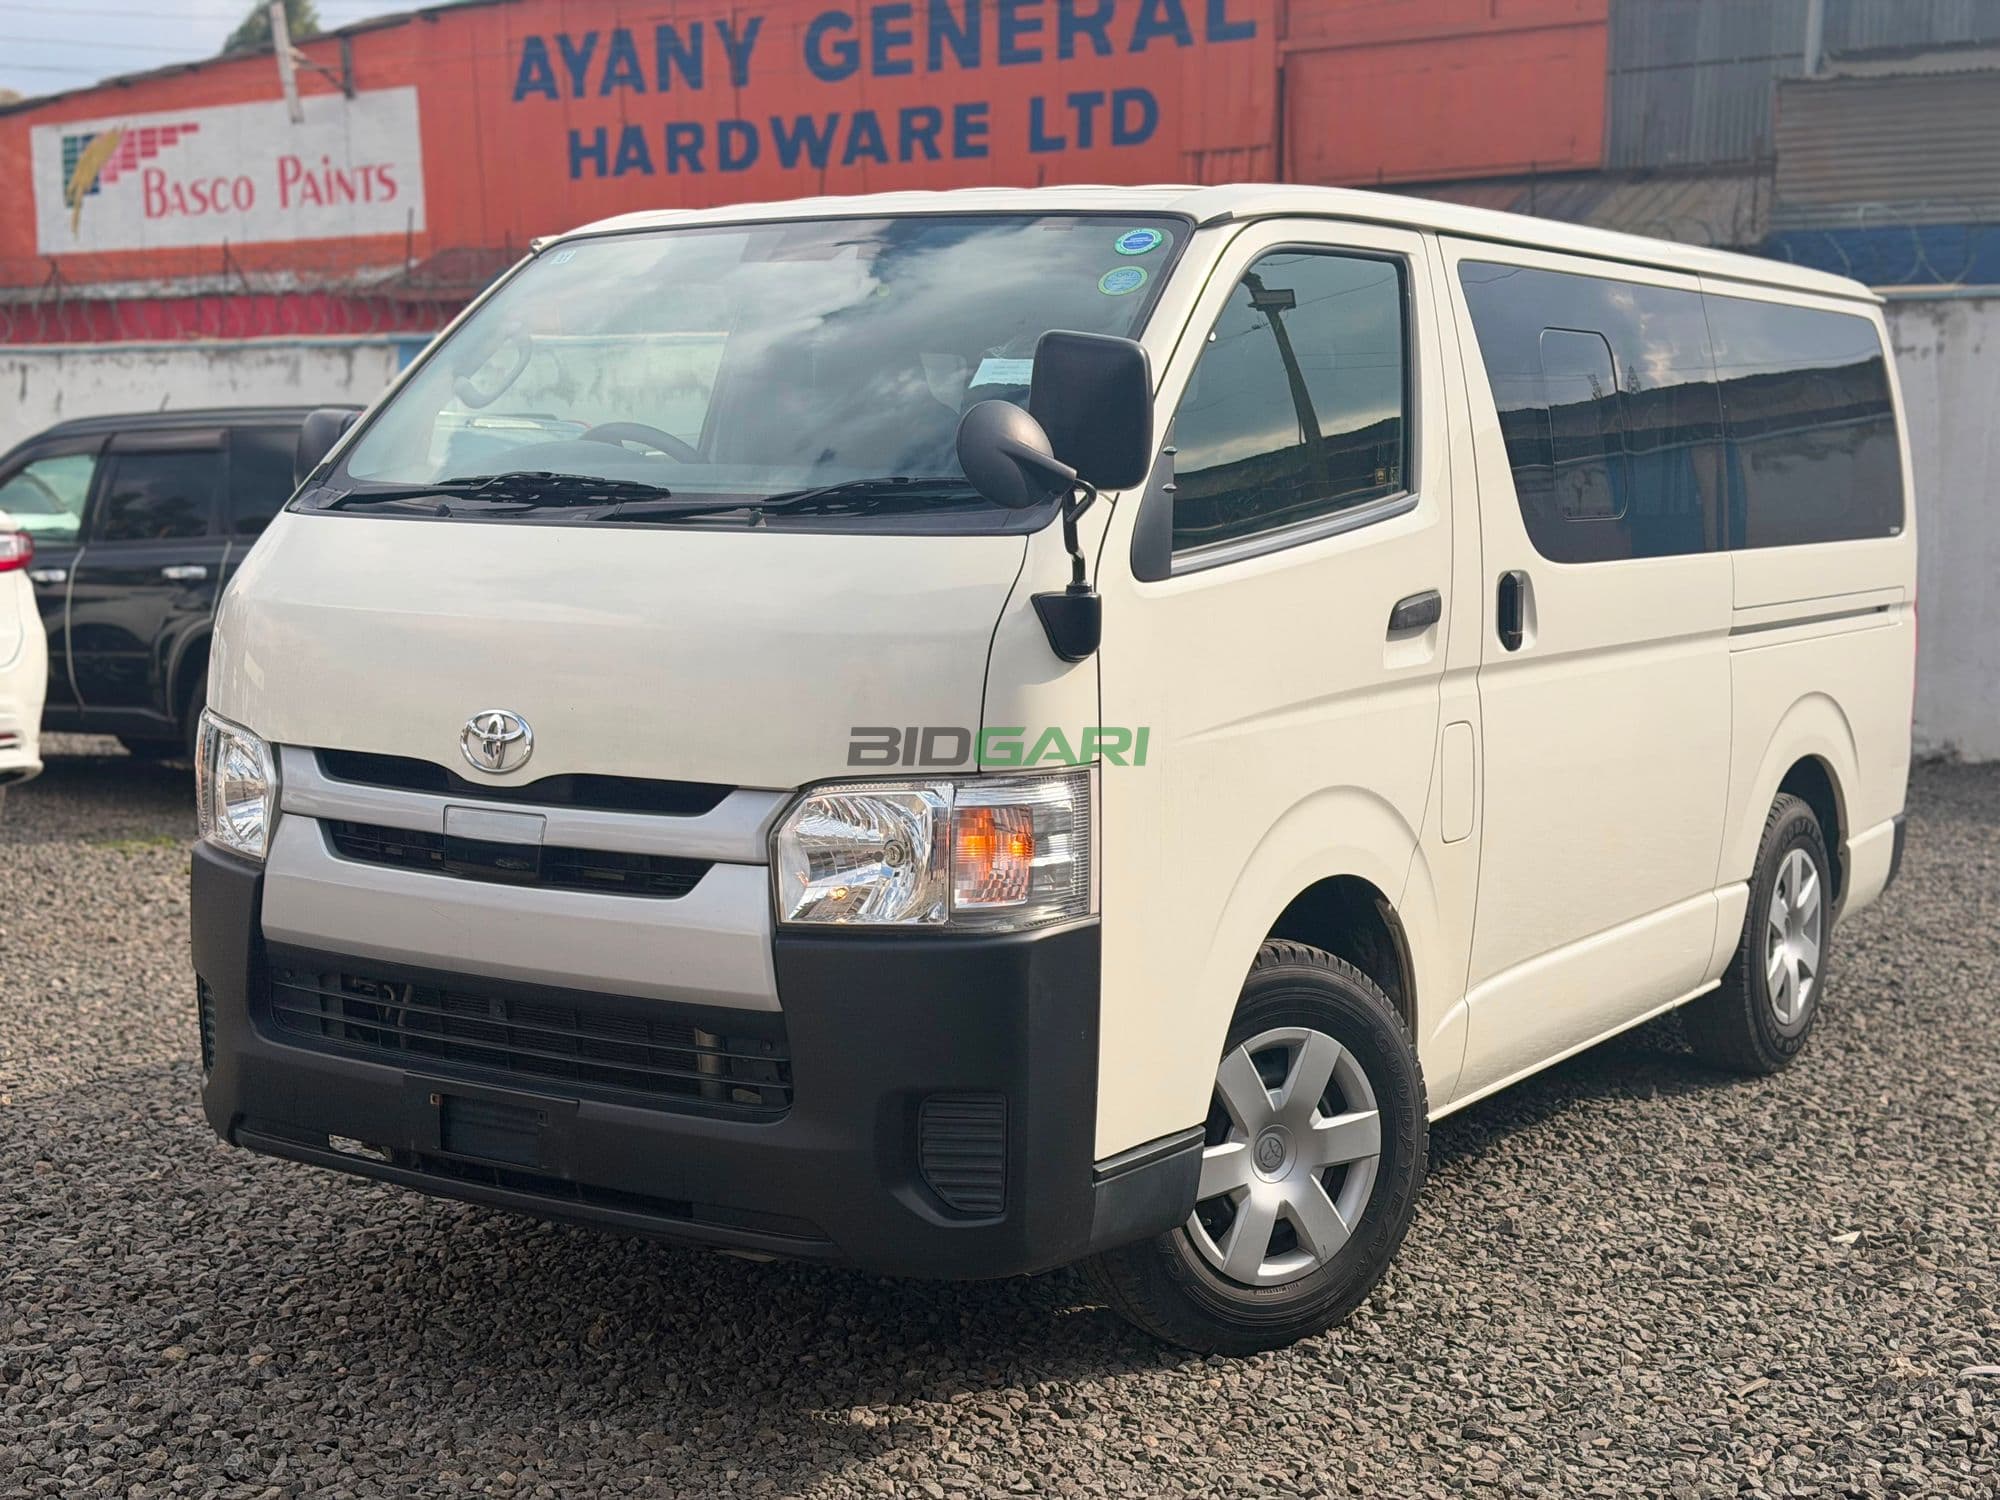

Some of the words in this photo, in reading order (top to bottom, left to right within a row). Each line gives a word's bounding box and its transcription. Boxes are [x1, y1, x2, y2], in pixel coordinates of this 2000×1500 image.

[512, 15, 764, 102] AYANY
[803, 0, 1258, 83] GENERAL
[568, 101, 990, 180] HARDWARE
[1028, 87, 1160, 154] LTD
[1352, 1029, 1416, 1280] GOODYEAR
